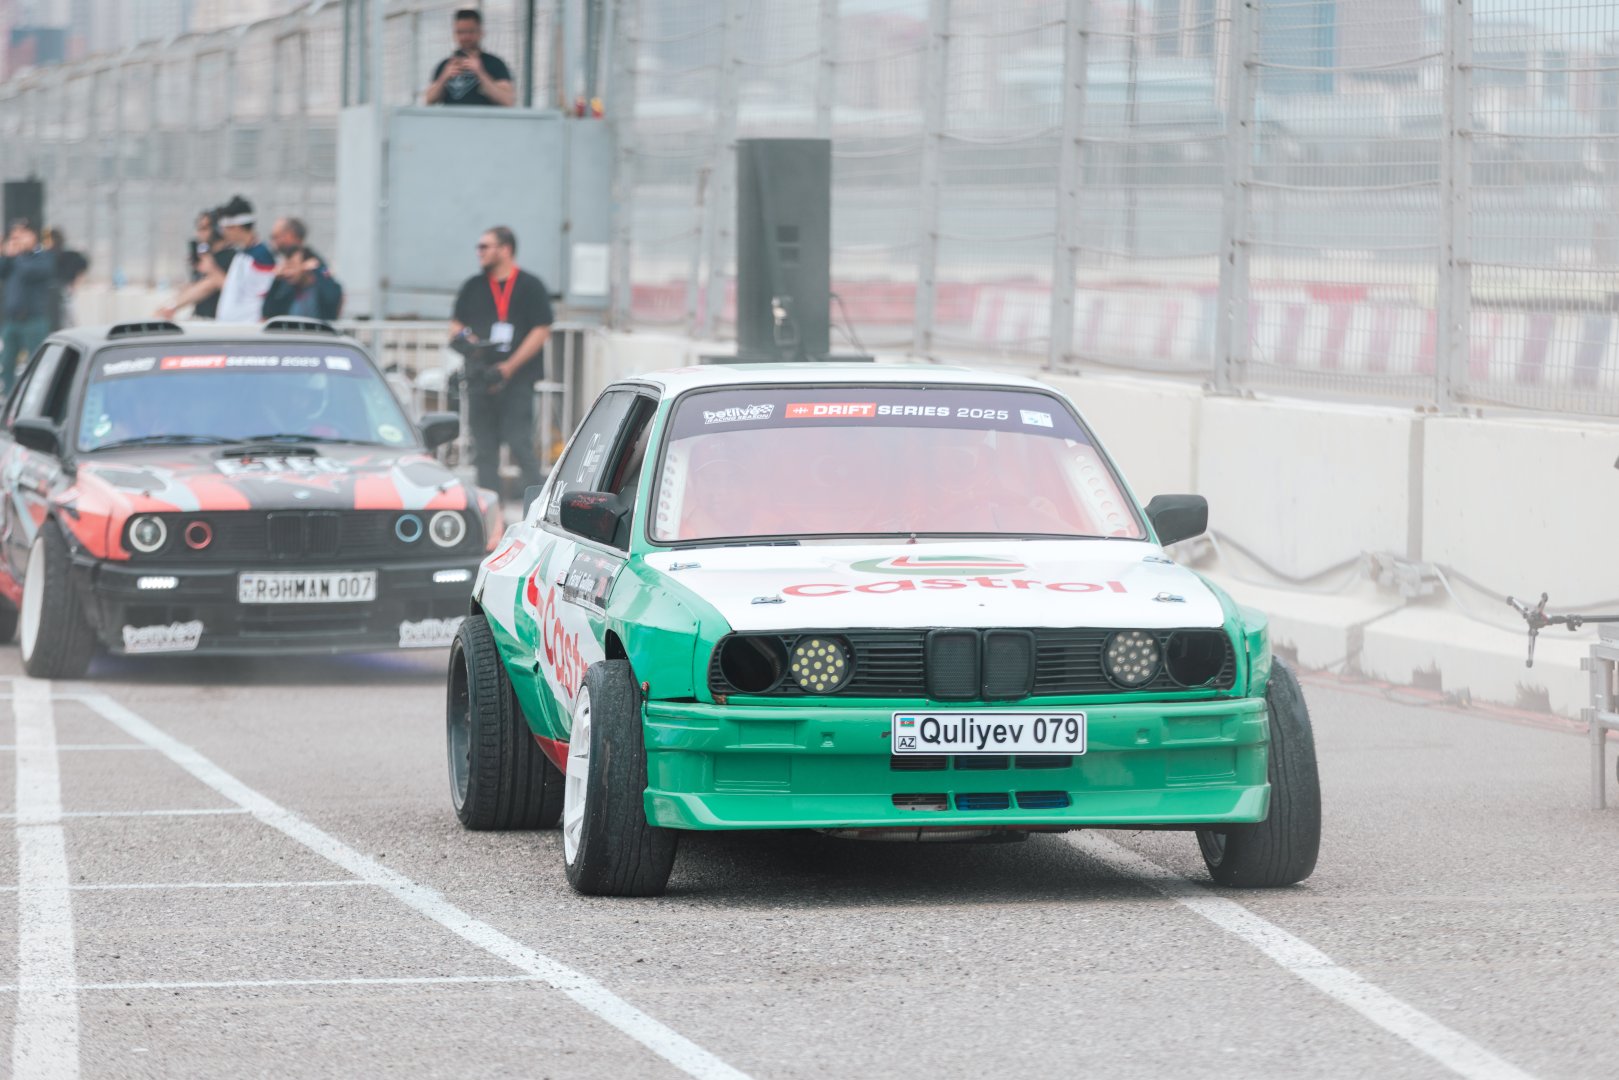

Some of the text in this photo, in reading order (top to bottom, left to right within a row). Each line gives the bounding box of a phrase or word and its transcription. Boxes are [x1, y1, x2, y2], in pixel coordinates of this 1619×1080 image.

[813, 405, 872, 416] DRIFT
[877, 405, 950, 417] SERIES
[956, 408, 1009, 420] 2025
[338, 577, 371, 597] 007
[900, 717, 1079, 750] AZ Quliyev 079
